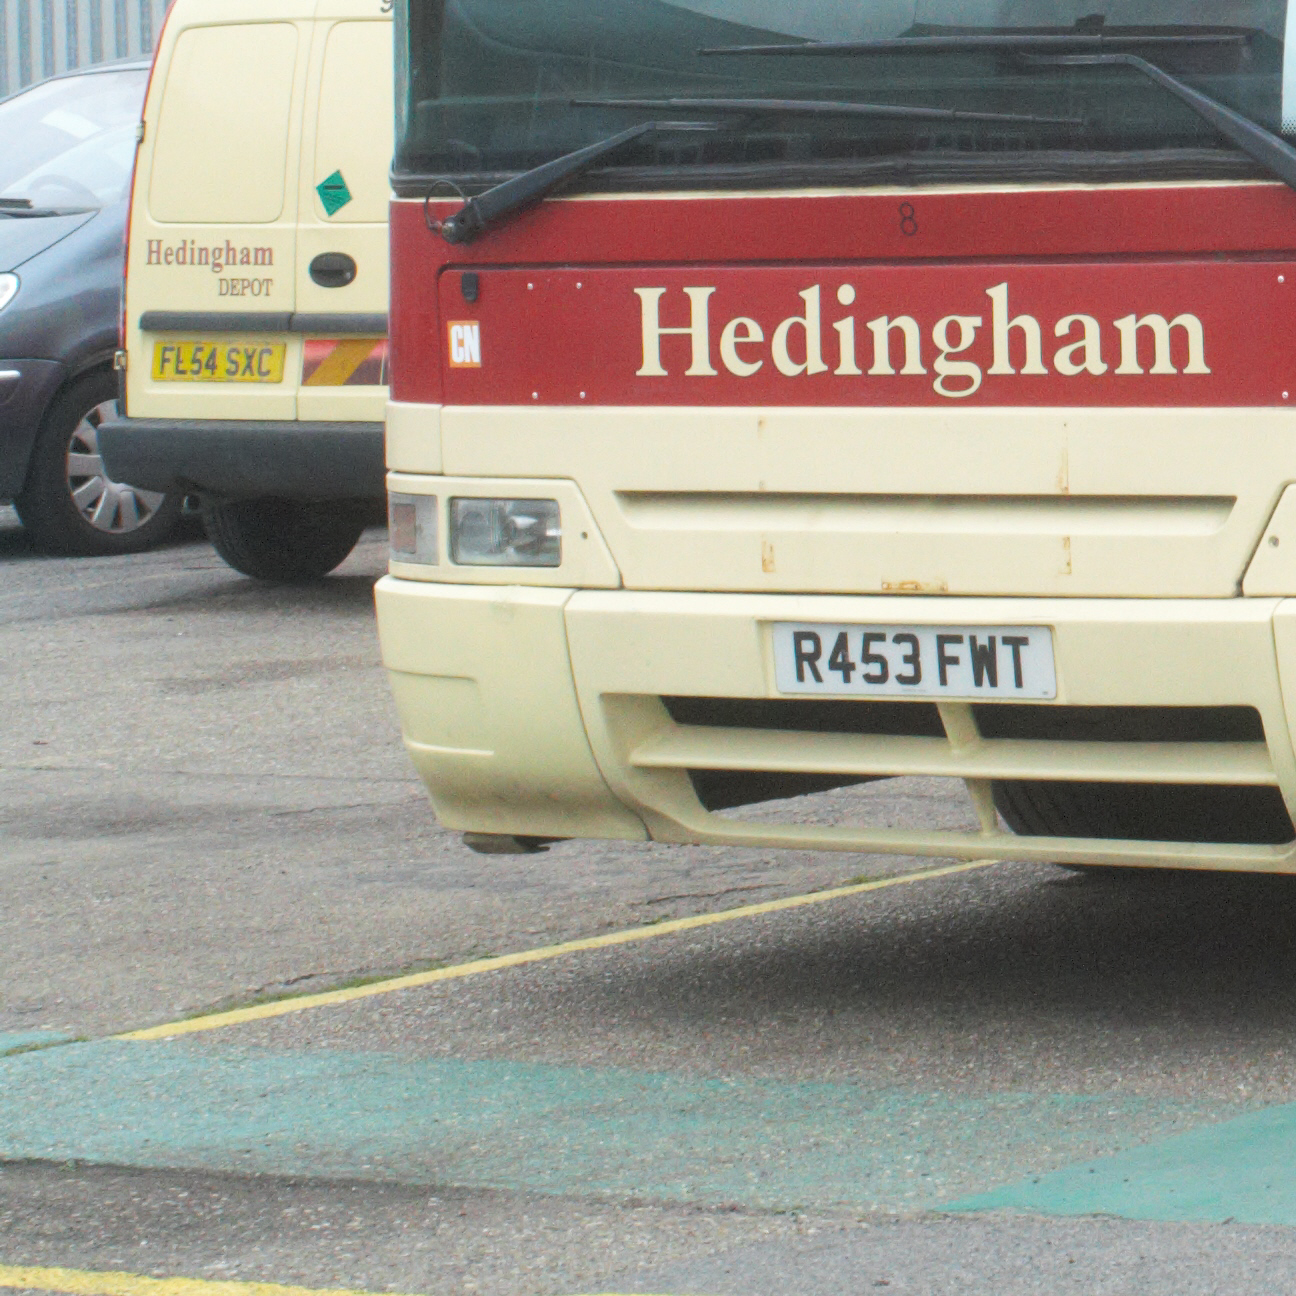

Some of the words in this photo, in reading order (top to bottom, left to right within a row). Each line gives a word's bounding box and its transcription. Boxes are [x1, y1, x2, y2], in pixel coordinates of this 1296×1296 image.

[898, 202, 919, 236] 8
[145, 239, 274, 274] Hedingham
[218, 278, 274, 297] DEPOT
[450, 324, 481, 364] CN
[633, 282, 1211, 398] Hedingham
[159, 345, 218, 376] FL54
[225, 347, 273, 377] SXC
[793, 630, 923, 686] R453
[935, 633, 1030, 689] FWT
